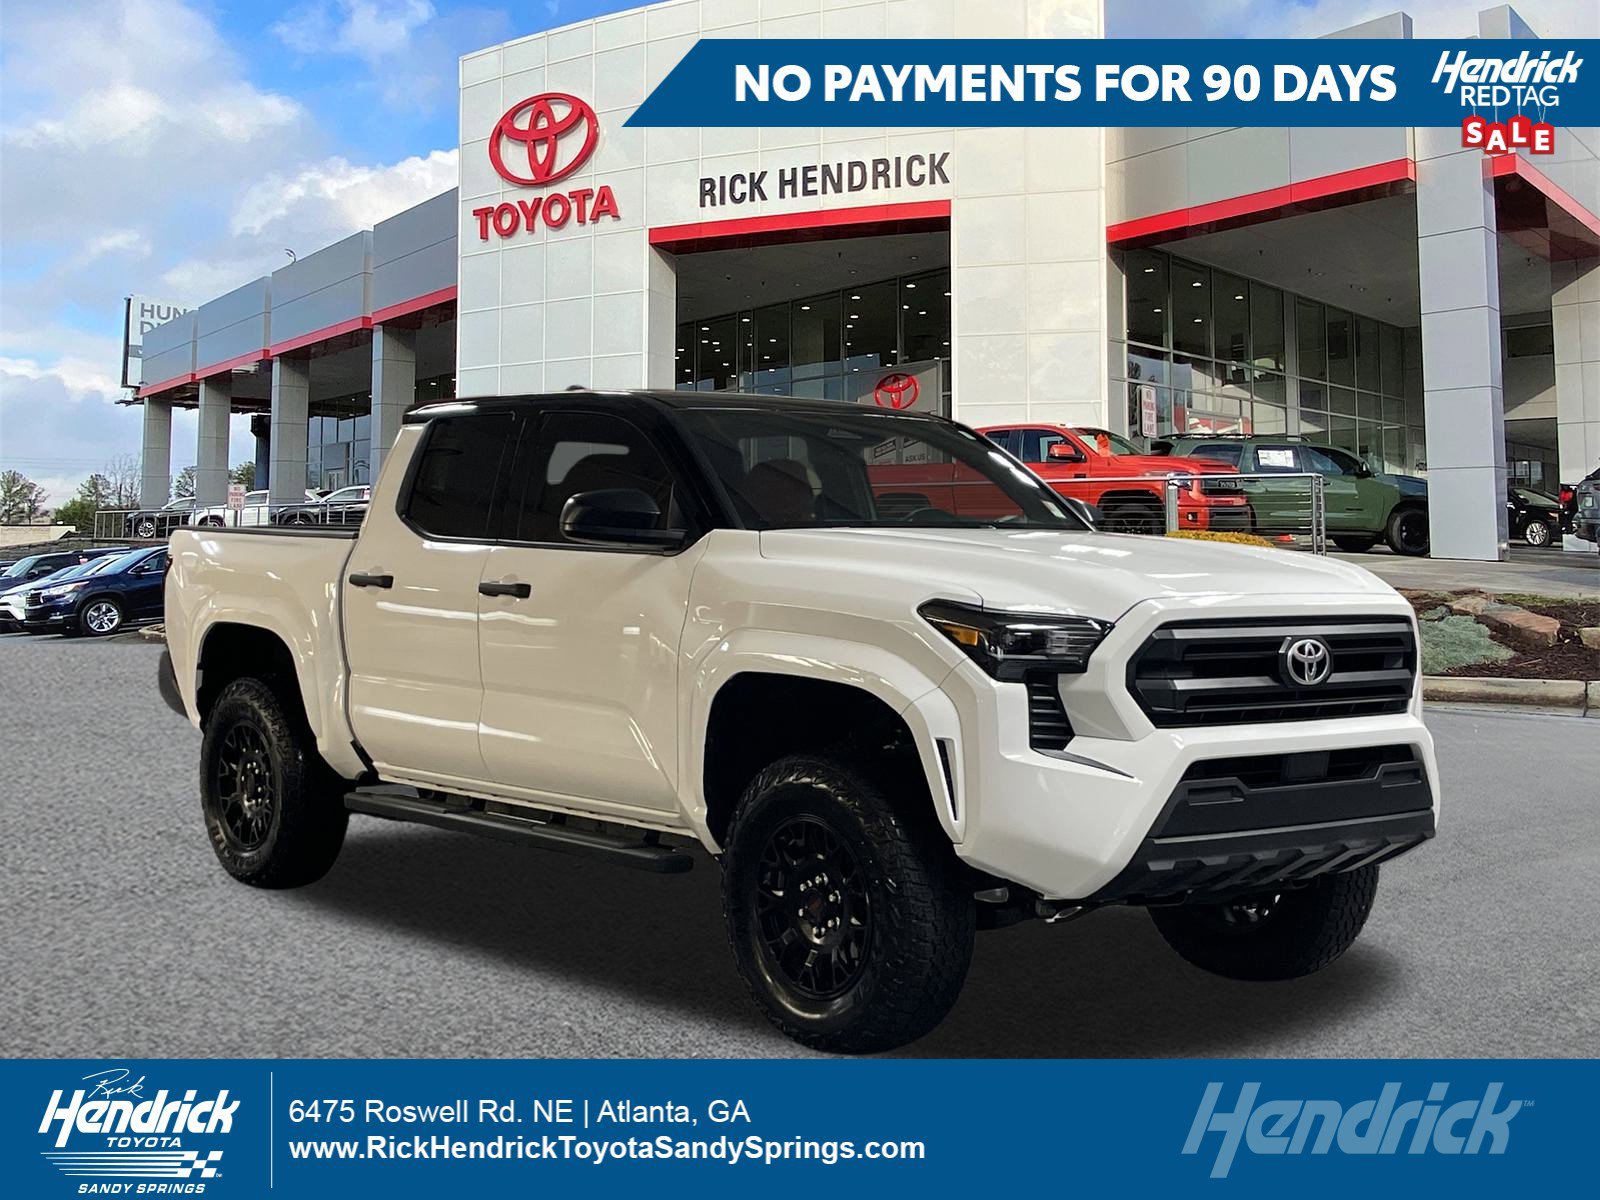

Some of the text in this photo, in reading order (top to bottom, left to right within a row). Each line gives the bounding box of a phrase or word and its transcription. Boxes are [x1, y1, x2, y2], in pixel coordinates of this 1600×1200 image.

[699, 152, 950, 208] RICK HENDRICK
[472, 185, 620, 240] TOYOTA
